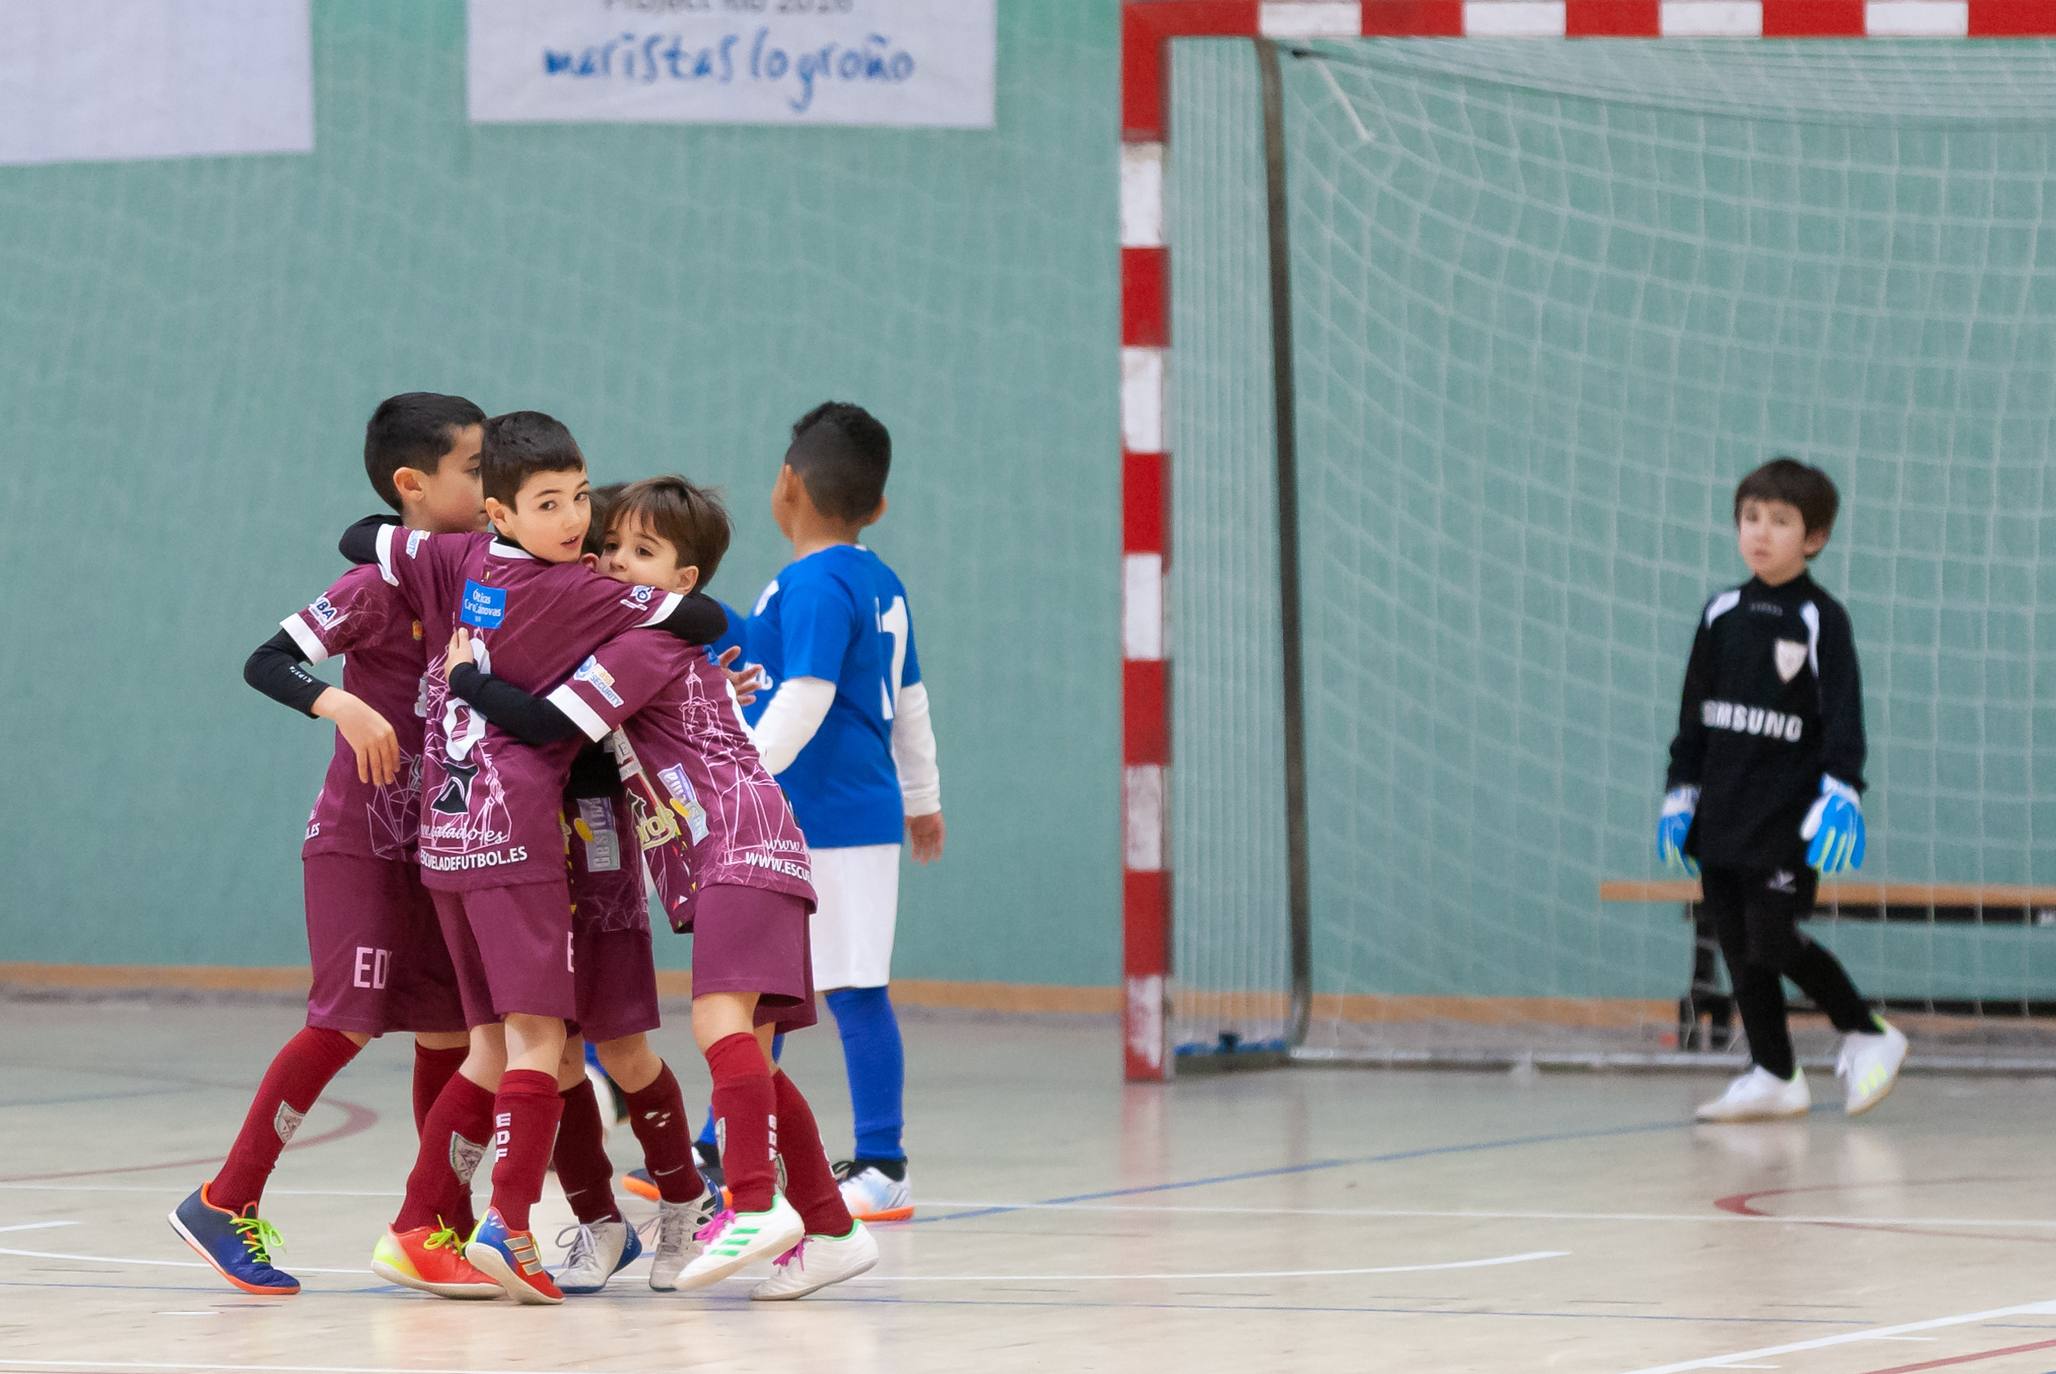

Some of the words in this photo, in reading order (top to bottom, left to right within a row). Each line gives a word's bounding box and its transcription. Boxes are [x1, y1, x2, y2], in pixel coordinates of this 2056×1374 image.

[542, 32, 739, 85] maristas
[749, 25, 915, 113] logroño
[589, 673, 622, 707] SECURITY
